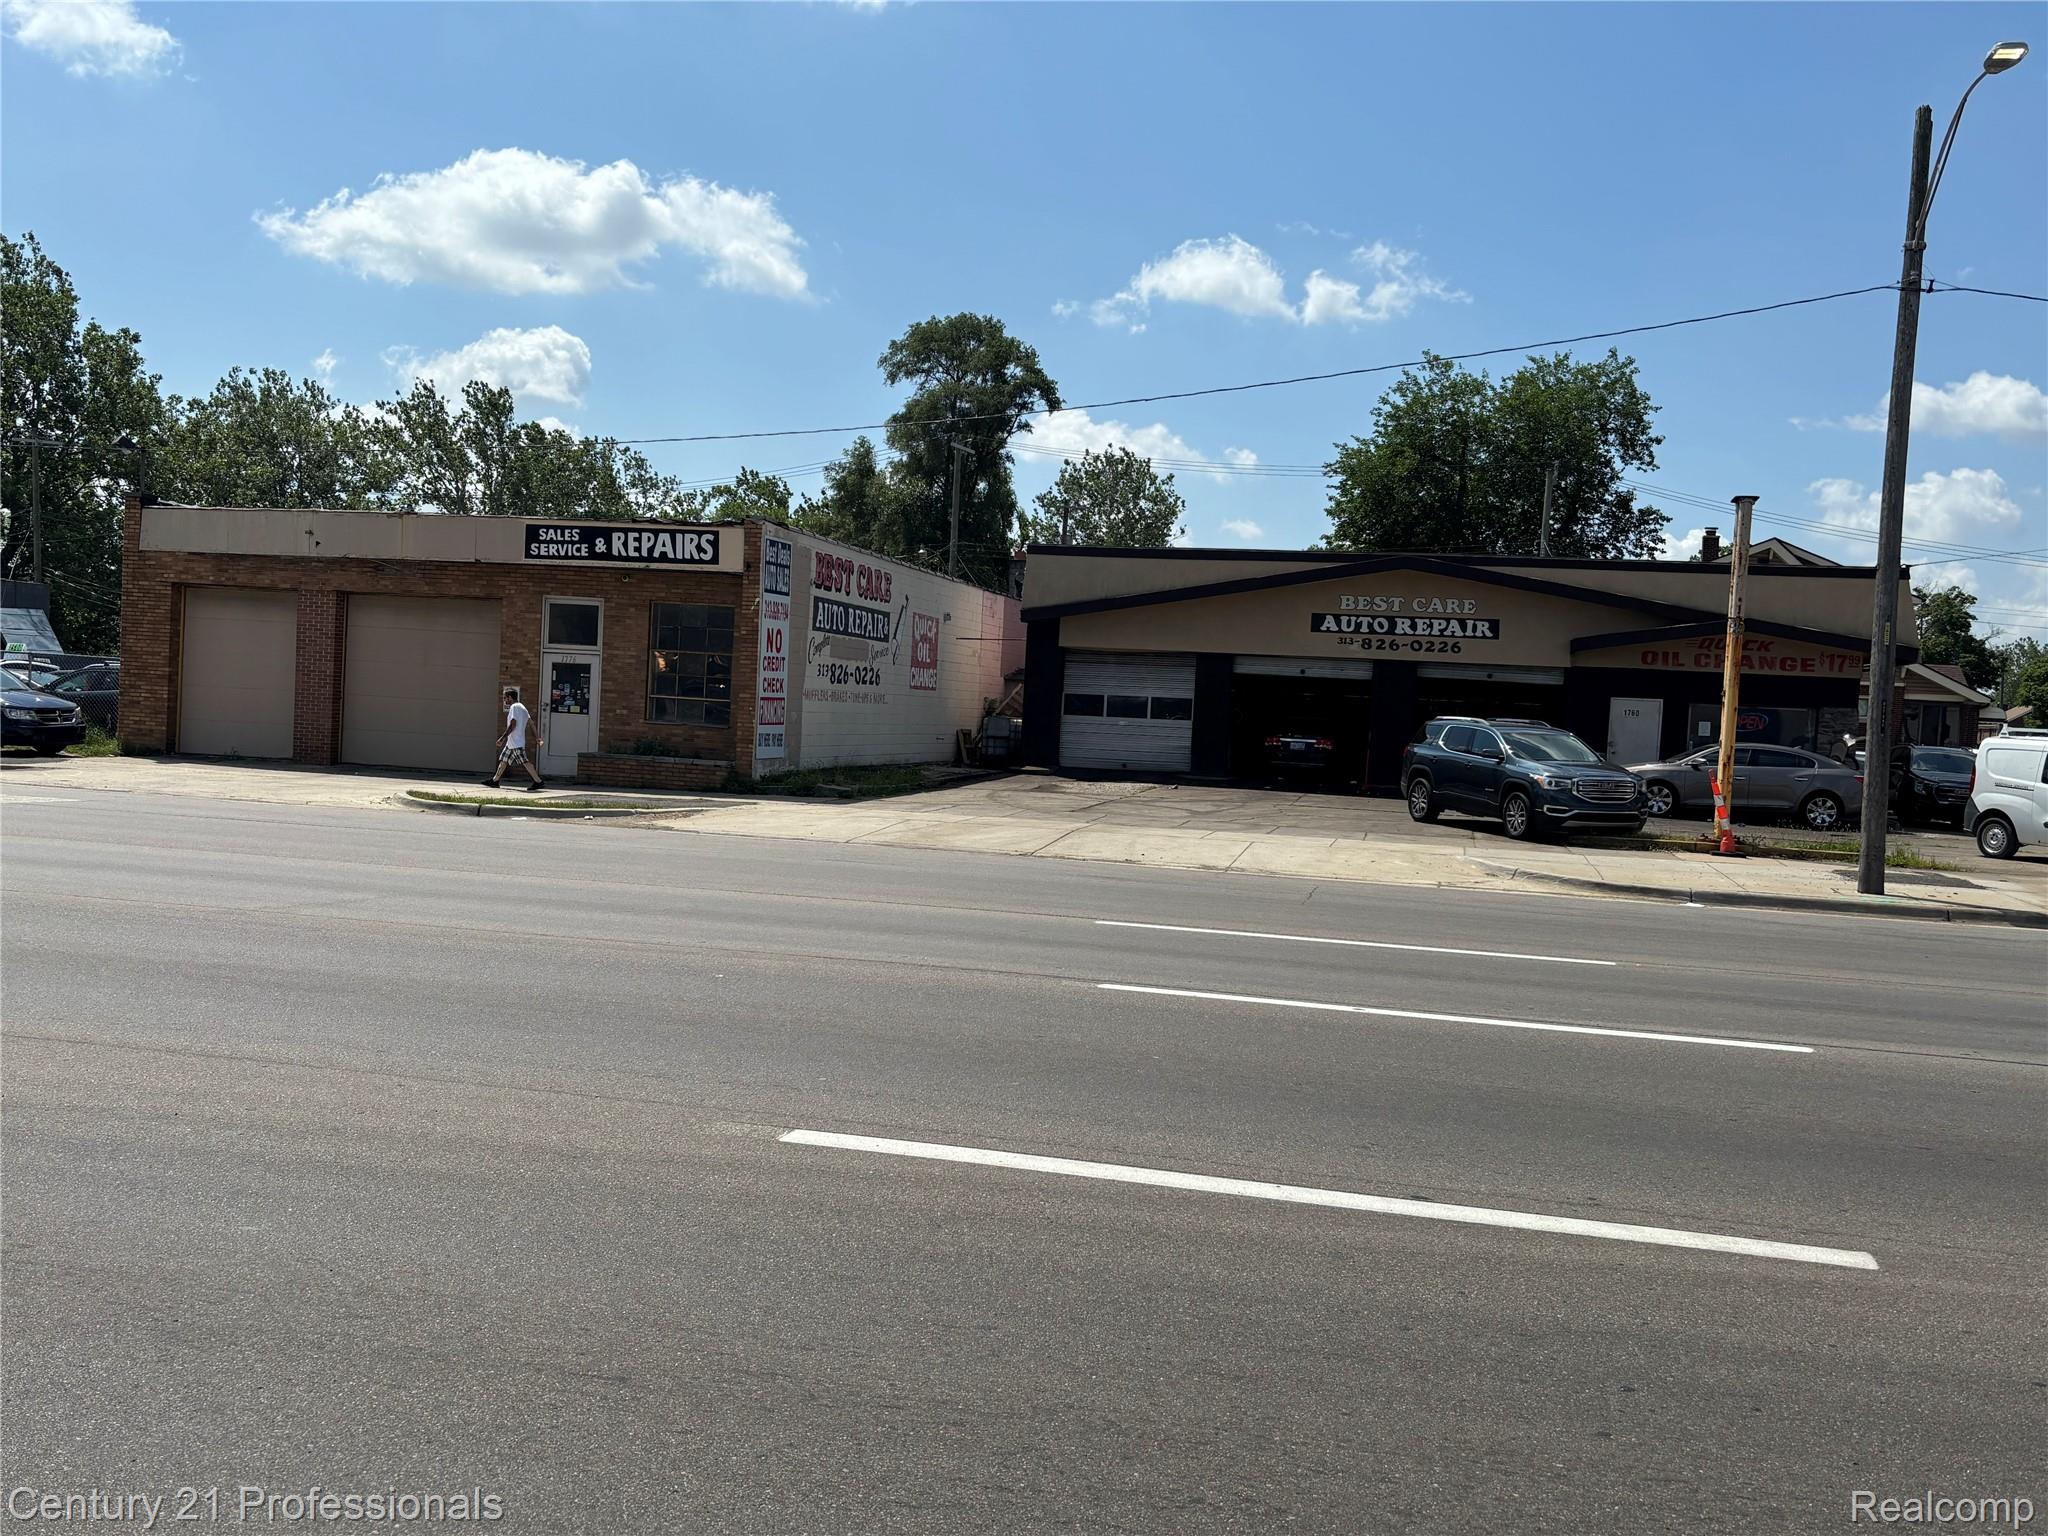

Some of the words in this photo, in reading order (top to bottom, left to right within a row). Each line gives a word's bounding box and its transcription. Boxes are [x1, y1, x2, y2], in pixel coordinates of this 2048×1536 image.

[539, 528, 580, 541] SALES
[530, 543, 589, 557] SERVICE
[594, 537, 607, 553] &
[611, 531, 715, 561] REPAIRS
[766, 539, 778, 563] Best
[777, 566, 790, 593] SALES
[813, 551, 855, 597] BEST
[856, 564, 893, 604] CARE
[1339, 595, 1405, 612] BEST
[1412, 597, 1477, 615] CARE
[815, 601, 845, 632] AUTO
[848, 607, 884, 639] REPAIR
[1319, 614, 1389, 634] AUTO
[1394, 617, 1493, 638] REPAIR
[766, 627, 783, 654] NO
[1697, 637, 1776, 652] QUCK
[868, 644, 889, 667] Service
[917, 641, 931, 663] OIL
[1640, 650, 1685, 667] OIL
[762, 656, 786, 672] CREDIT
[816, 663, 829, 678] 313
[829, 663, 881, 686] 826-0226
[762, 677, 784, 693] CHECK
[910, 666, 937, 688] CHANGE
[1738, 715, 1765, 730] PEN
